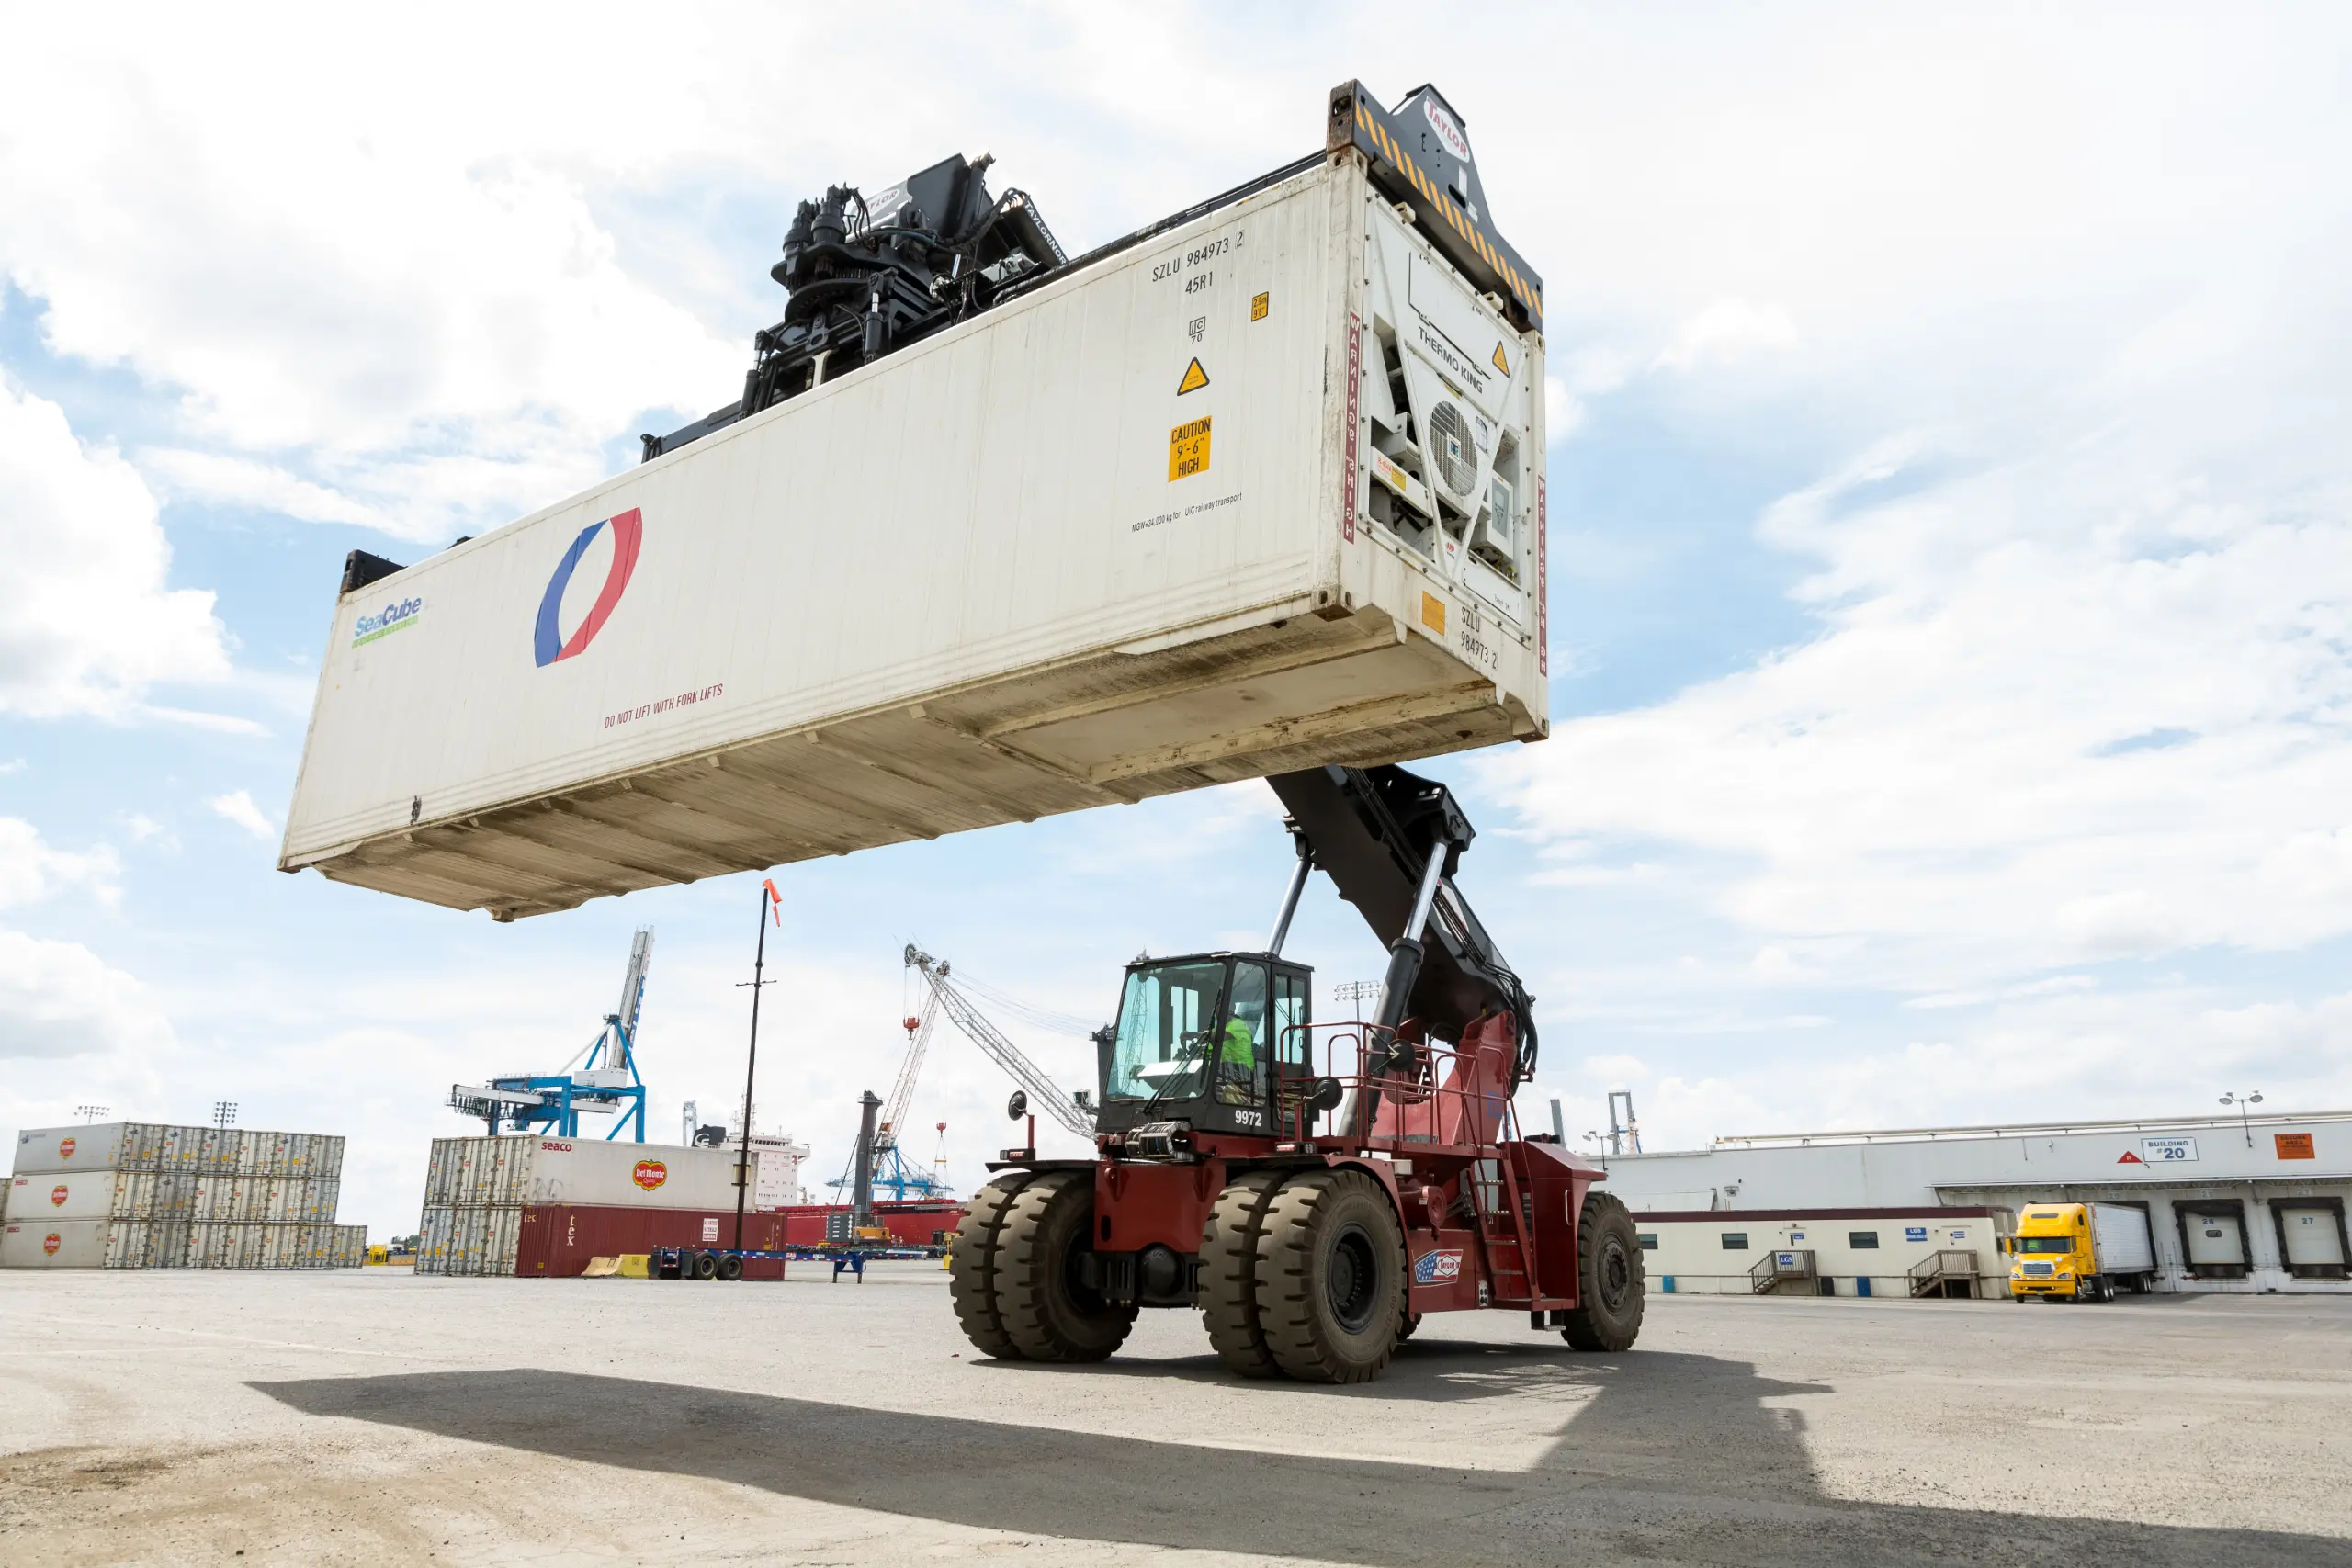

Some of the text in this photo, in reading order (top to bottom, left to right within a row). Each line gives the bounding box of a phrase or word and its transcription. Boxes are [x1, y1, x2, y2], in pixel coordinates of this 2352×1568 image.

[1428, 98, 1467, 156] TAYLOR
[1152, 231, 1243, 282] SZLU 984973 2
[1185, 271, 1213, 294] 45R1
[1191, 333, 1203, 344] 70
[1419, 325, 1483, 394] THERMO KING
[1171, 417, 1211, 444] CAUTION
[1177, 457, 1200, 478] HIGH
[1166, 513, 1172, 524] kg
[1173, 511, 1182, 521] for
[1184, 505, 1195, 516] UIC
[1195, 502, 1216, 513] railway
[1216, 491, 1242, 507] transport
[355, 597, 422, 637] SeaCube
[1461, 606, 1481, 633] SZLU
[1461, 630, 1489, 664] 984973
[605, 682, 723, 729] DO NOT LIFT WITH FORK LIFTS
[1235, 1110, 1262, 1127] 9972
[541, 1141, 572, 1152] seaco
[636, 1168, 646, 1178] Del
[566, 1214, 576, 1247] tex
[1440, 1258, 1455, 1269] TAYLOR
